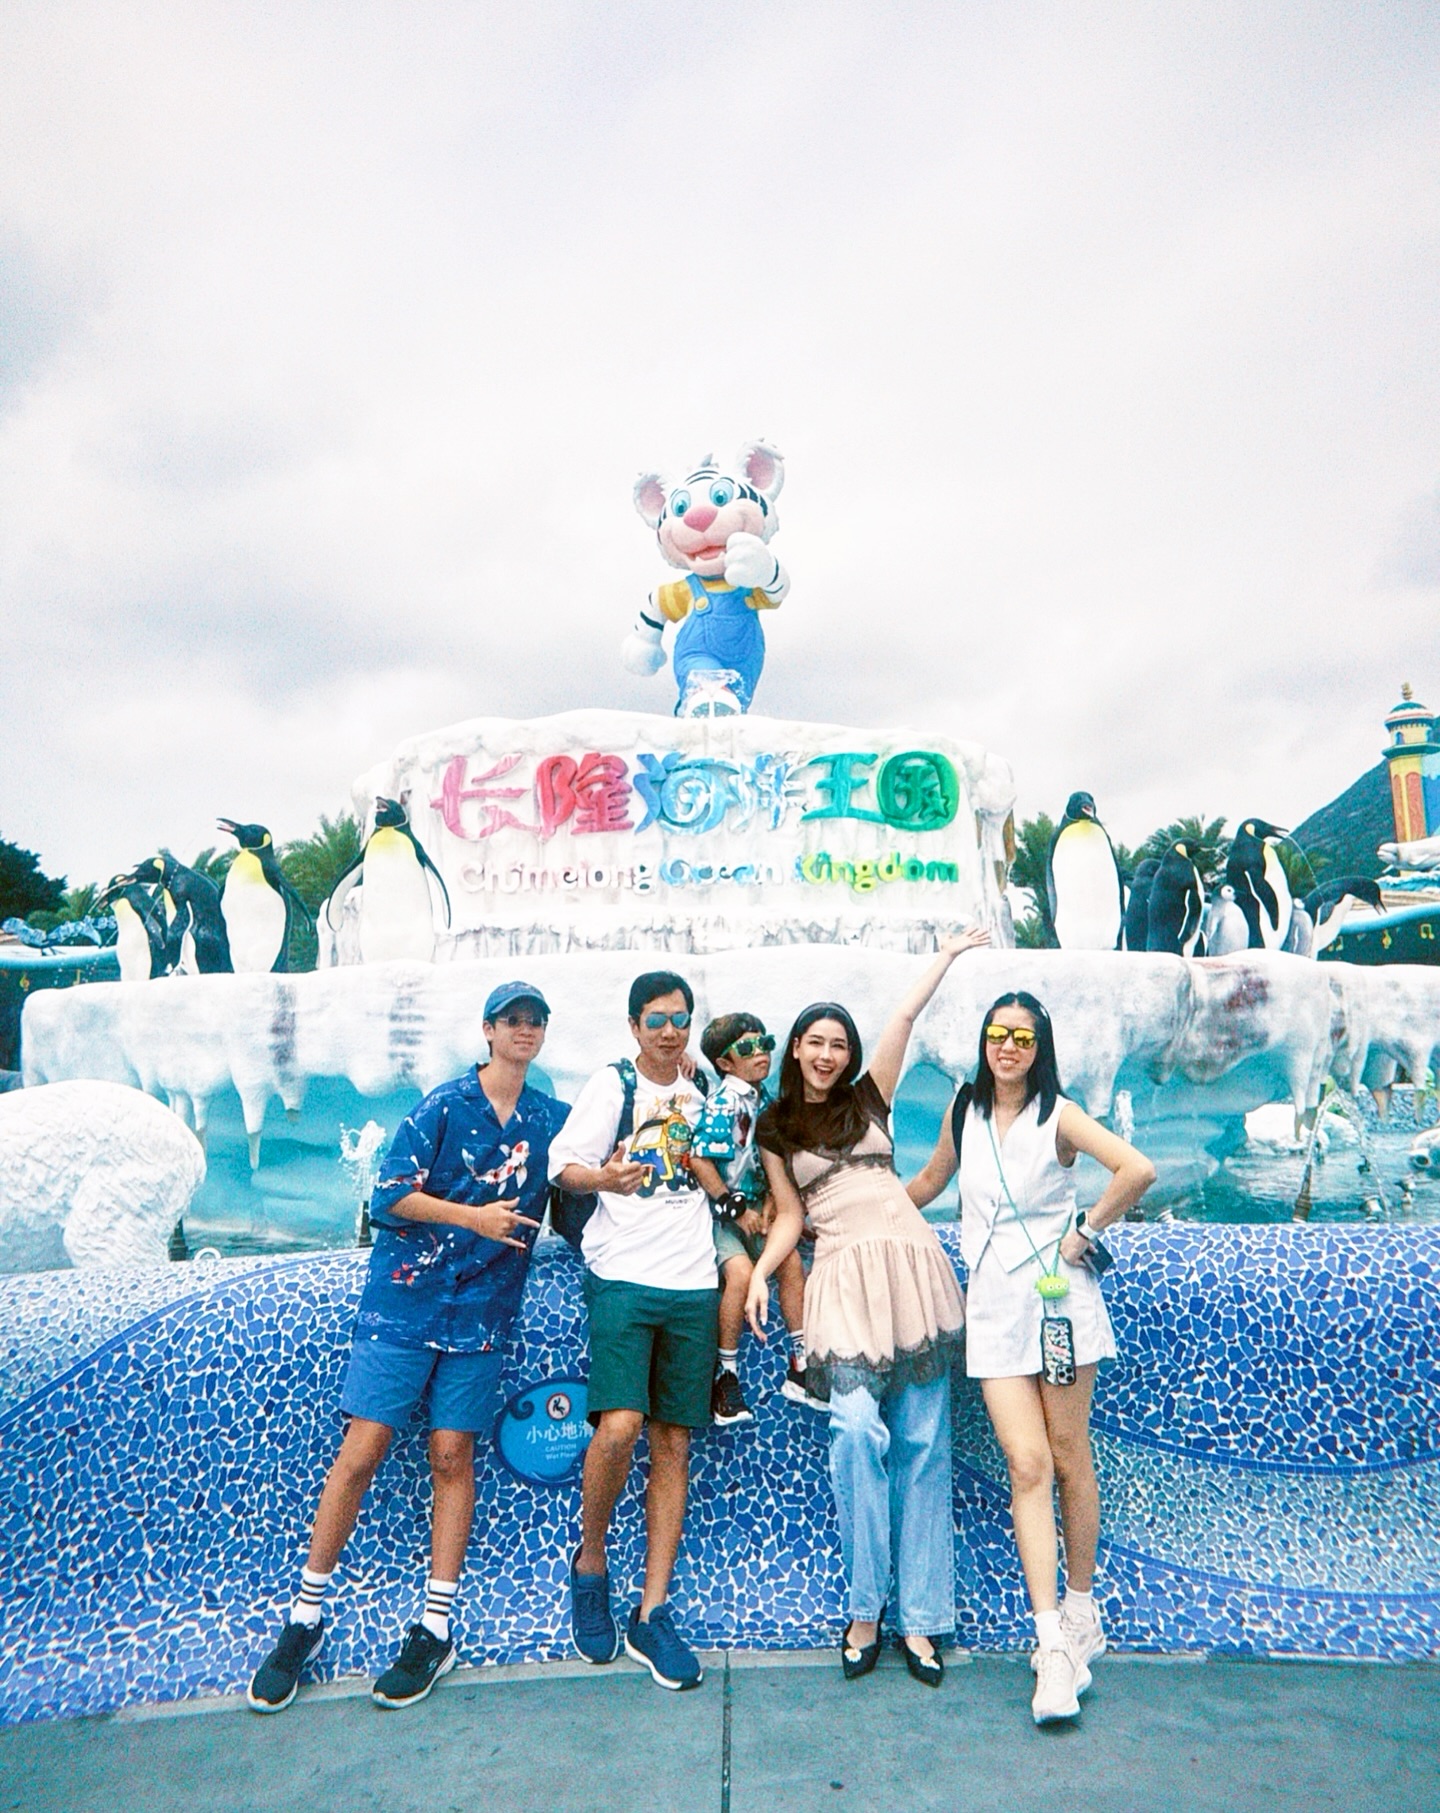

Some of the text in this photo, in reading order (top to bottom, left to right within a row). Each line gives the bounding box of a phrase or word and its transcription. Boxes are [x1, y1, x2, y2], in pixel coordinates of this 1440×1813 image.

[429, 750, 960, 843] 长隆海洋王国
[658, 857, 783, 887] Ocean
[795, 851, 959, 893] Kingdom
[545, 1443, 577, 1452] CAUTION
